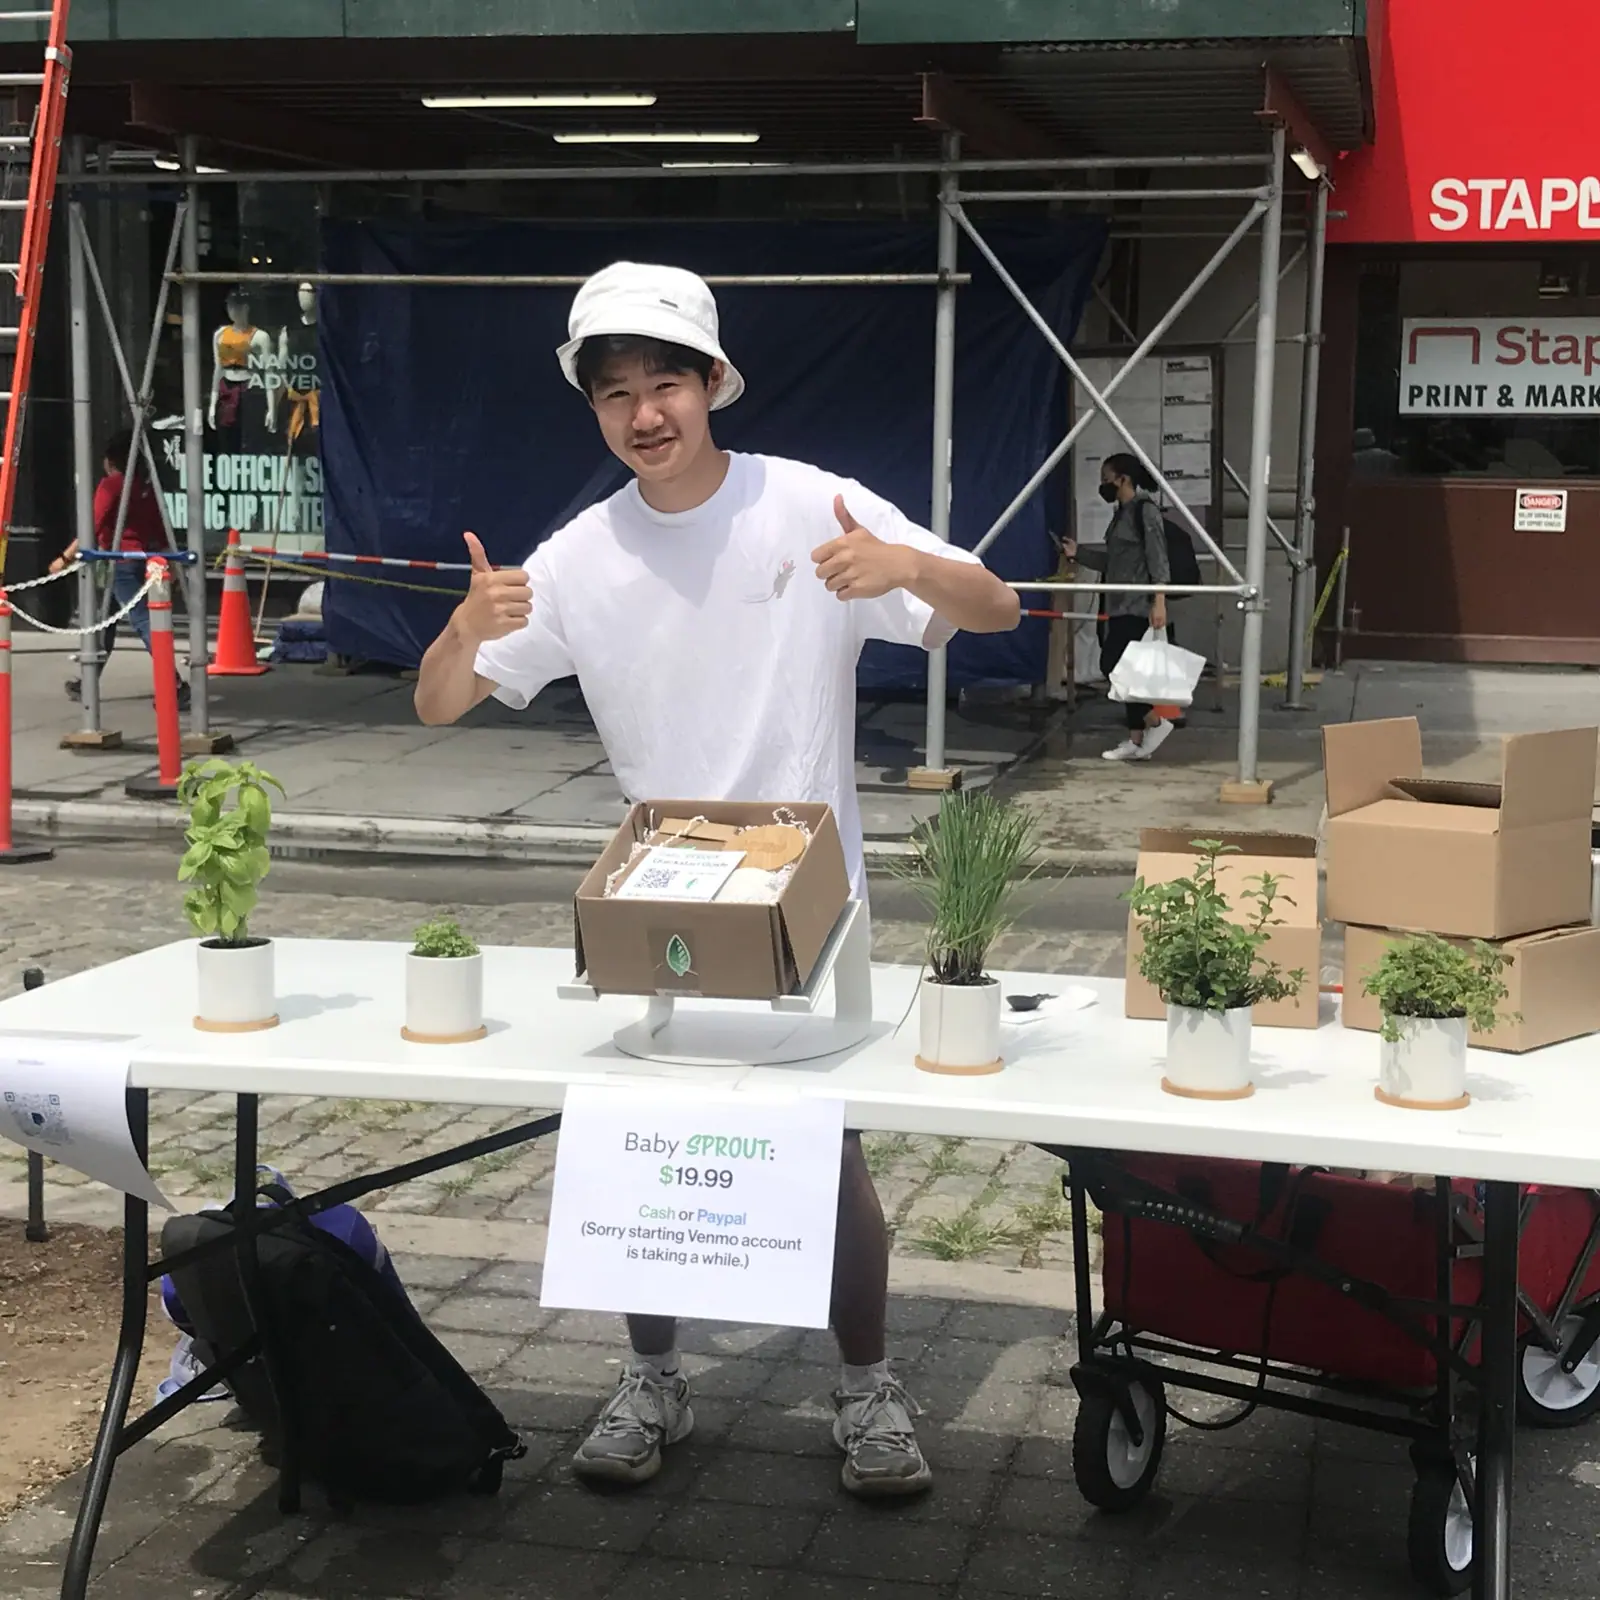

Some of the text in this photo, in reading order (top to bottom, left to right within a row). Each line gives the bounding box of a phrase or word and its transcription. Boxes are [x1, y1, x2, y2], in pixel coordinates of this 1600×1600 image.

[248, 354, 317, 370] NANO
[1408, 385, 1488, 408] PRINT
[1496, 384, 1514, 408] &
[625, 1132, 776, 1162] Baby SPROUT:
[659, 1165, 733, 1189] $19.99
[638, 1204, 747, 1227] Cash or Paypal
[581, 1222, 802, 1251] (Sorry starting Venmo account
[626, 1246, 749, 1269] is taking a while.)
